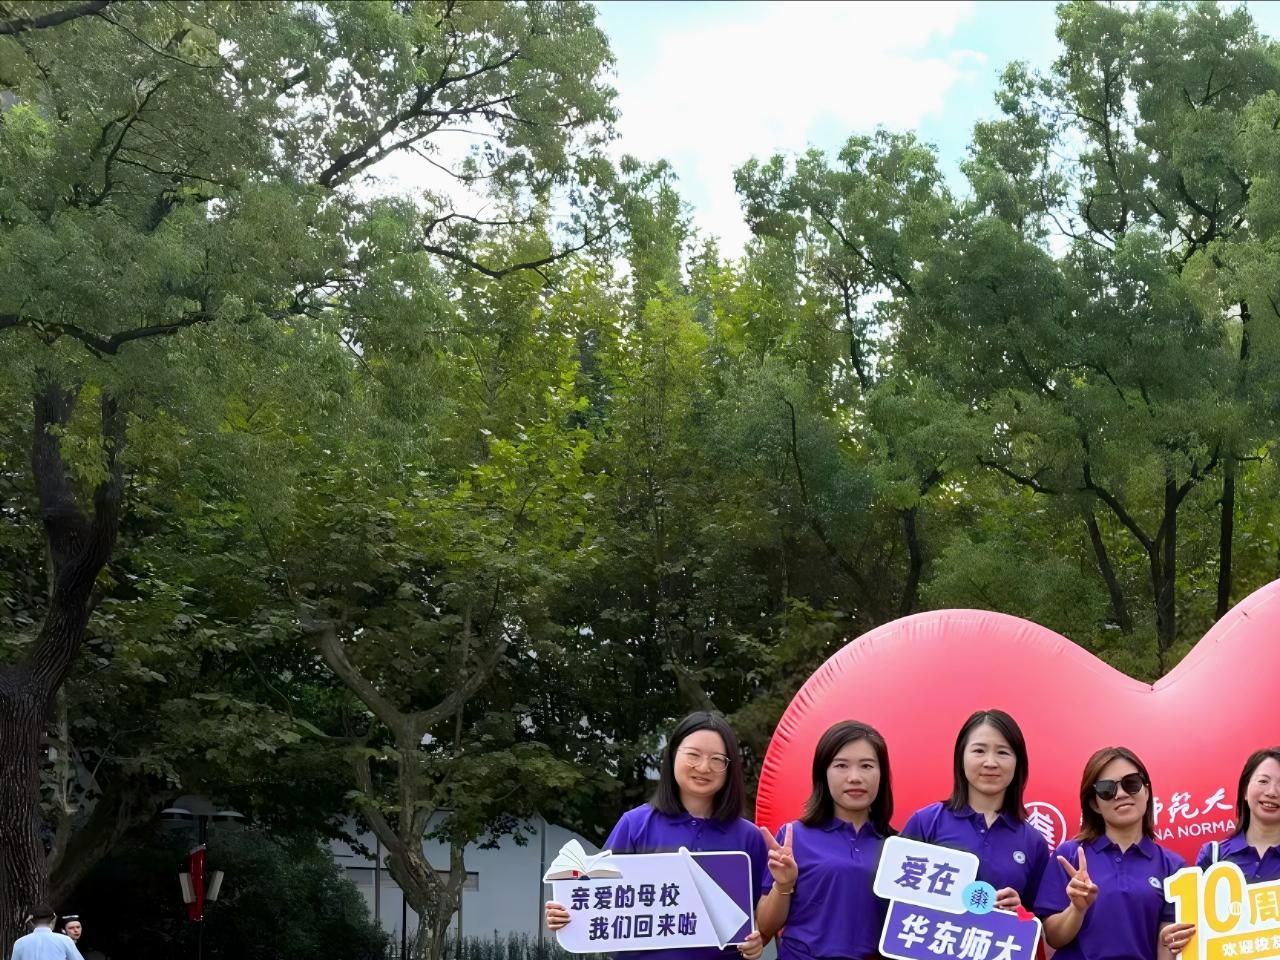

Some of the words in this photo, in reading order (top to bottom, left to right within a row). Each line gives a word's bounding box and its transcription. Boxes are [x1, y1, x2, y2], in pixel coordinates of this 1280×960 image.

[894, 855, 960, 896] 爱在
[571, 883, 680, 910] 亲爱的母校
[589, 912, 698, 940] 我们回来啦
